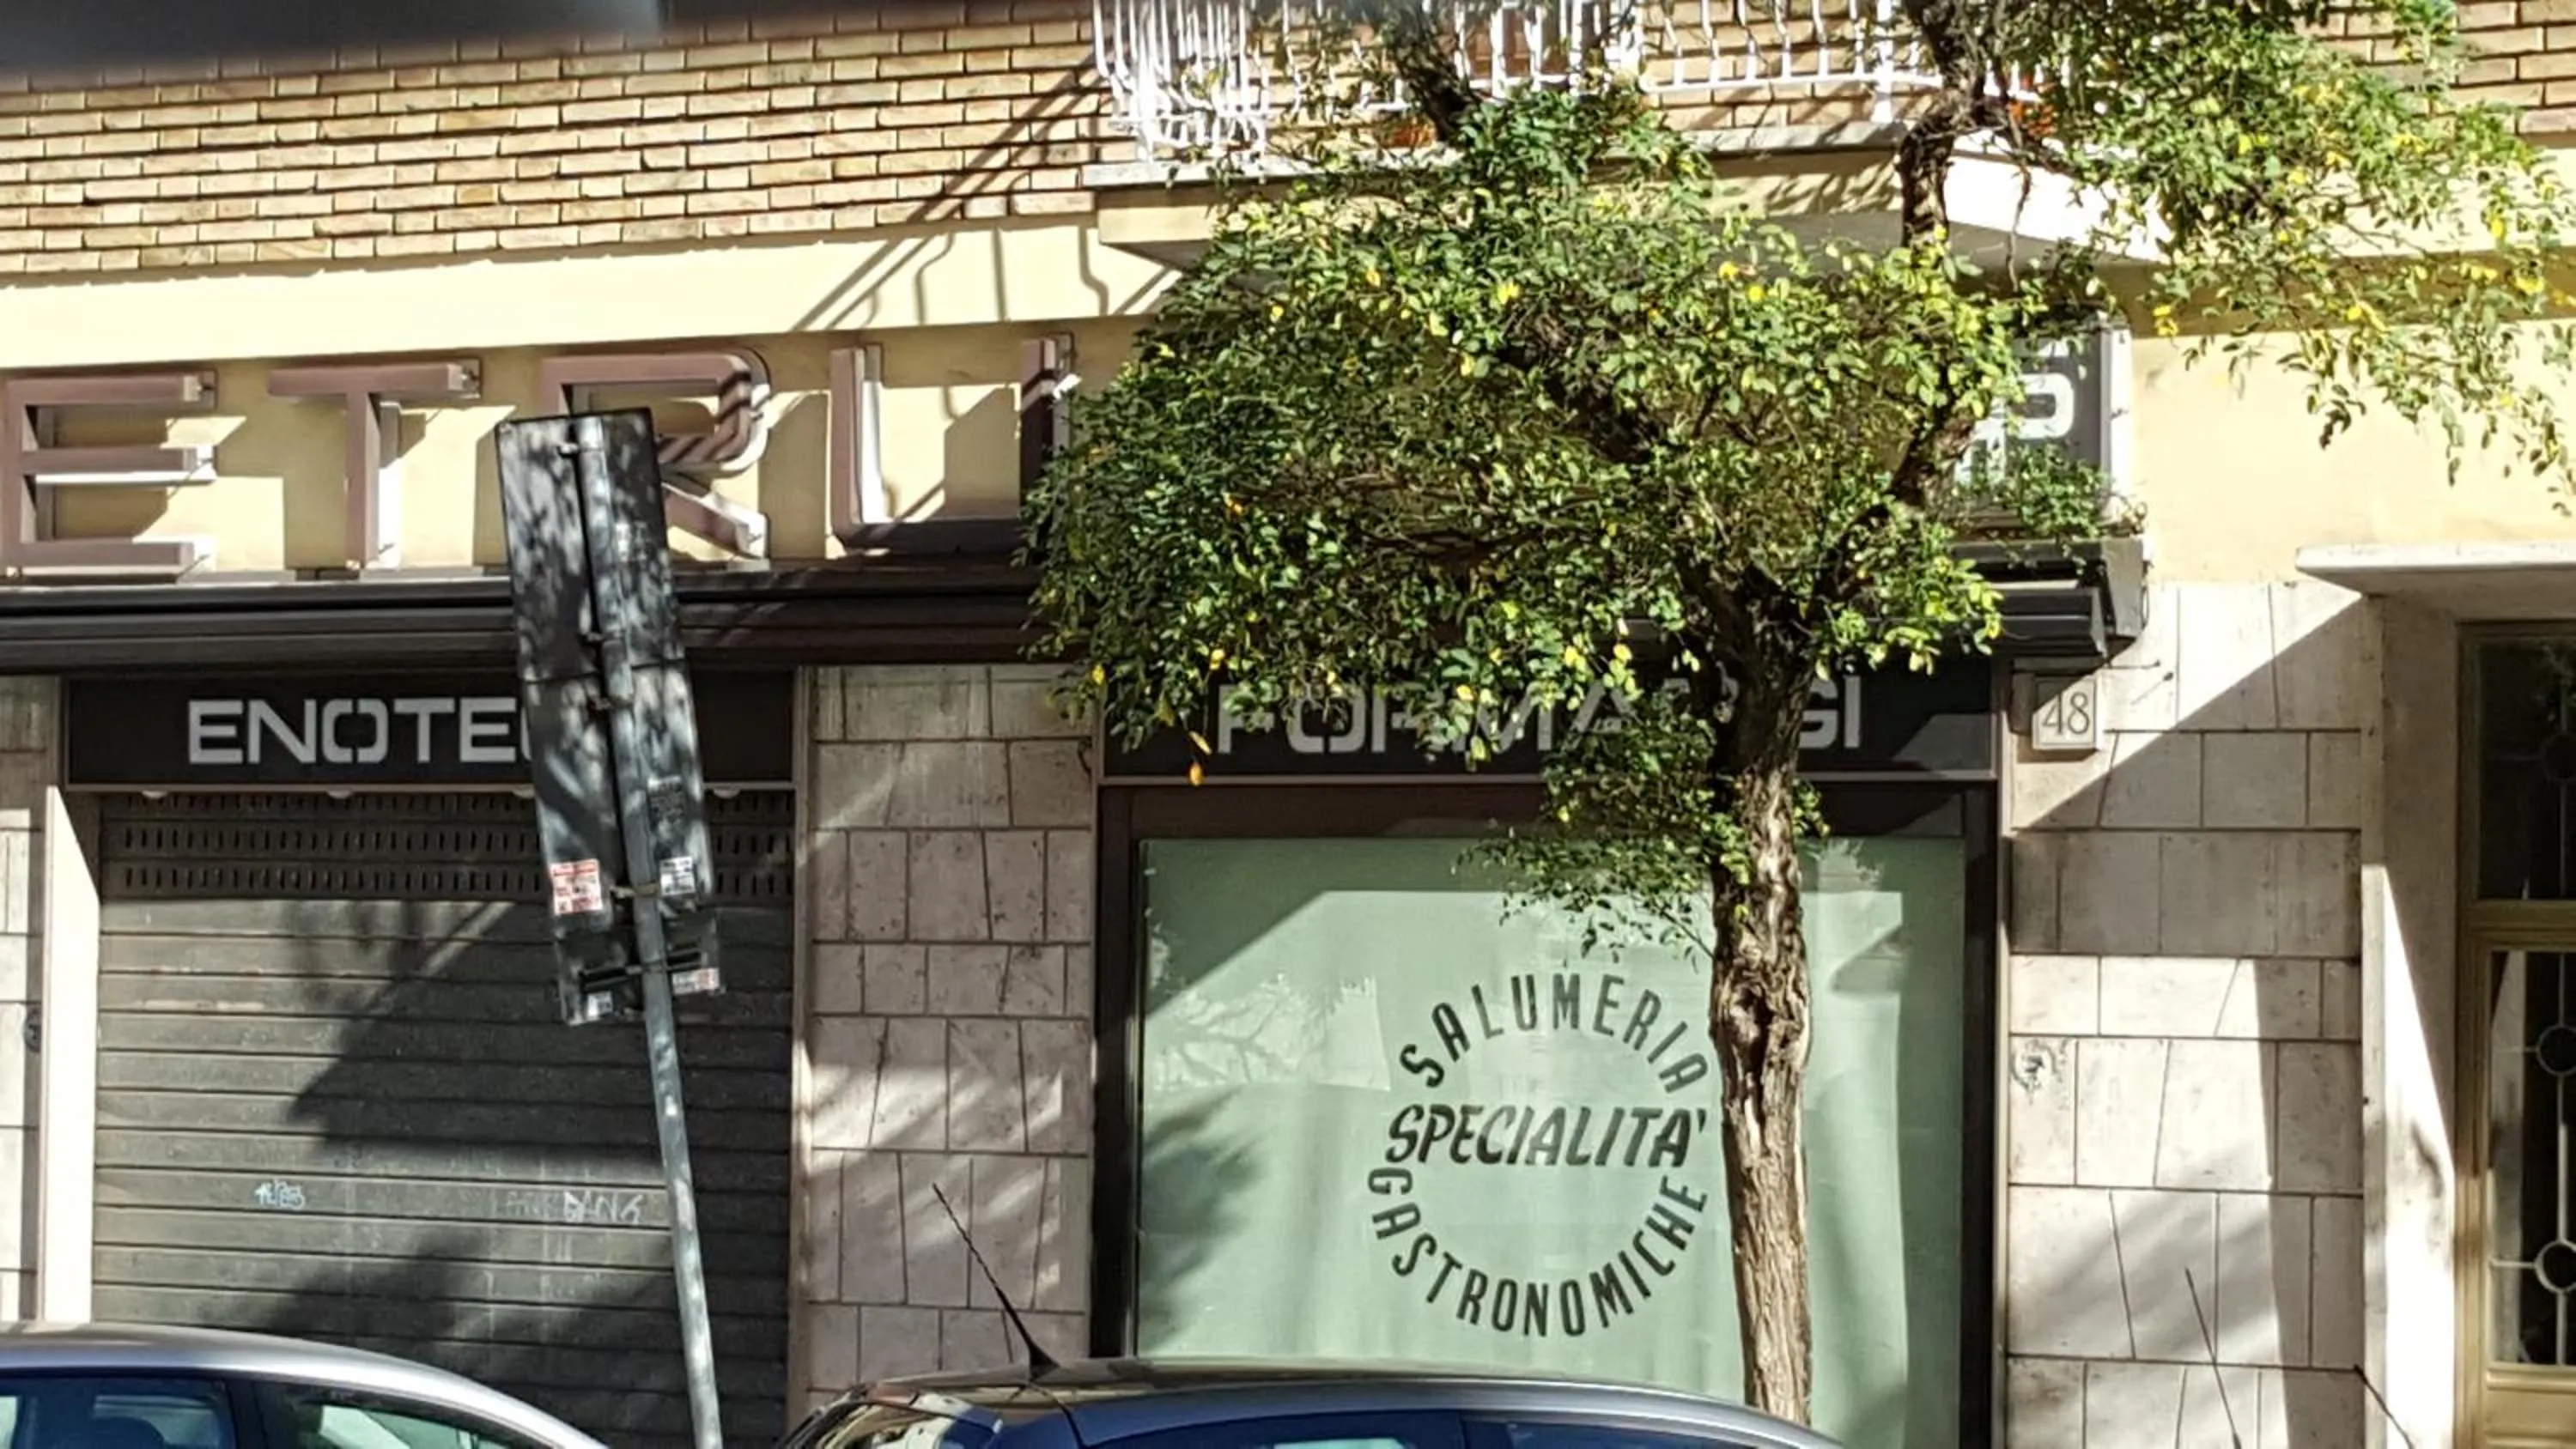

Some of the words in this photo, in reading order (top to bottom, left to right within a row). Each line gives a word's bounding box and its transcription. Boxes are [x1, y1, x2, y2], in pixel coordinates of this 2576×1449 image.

[188, 697, 533, 764] ENOTE
[2042, 691, 2090, 736] 48
[1399, 973, 1709, 1094] SALUMERIA
[1367, 1167, 1709, 1337] GASTRONOMICHE
